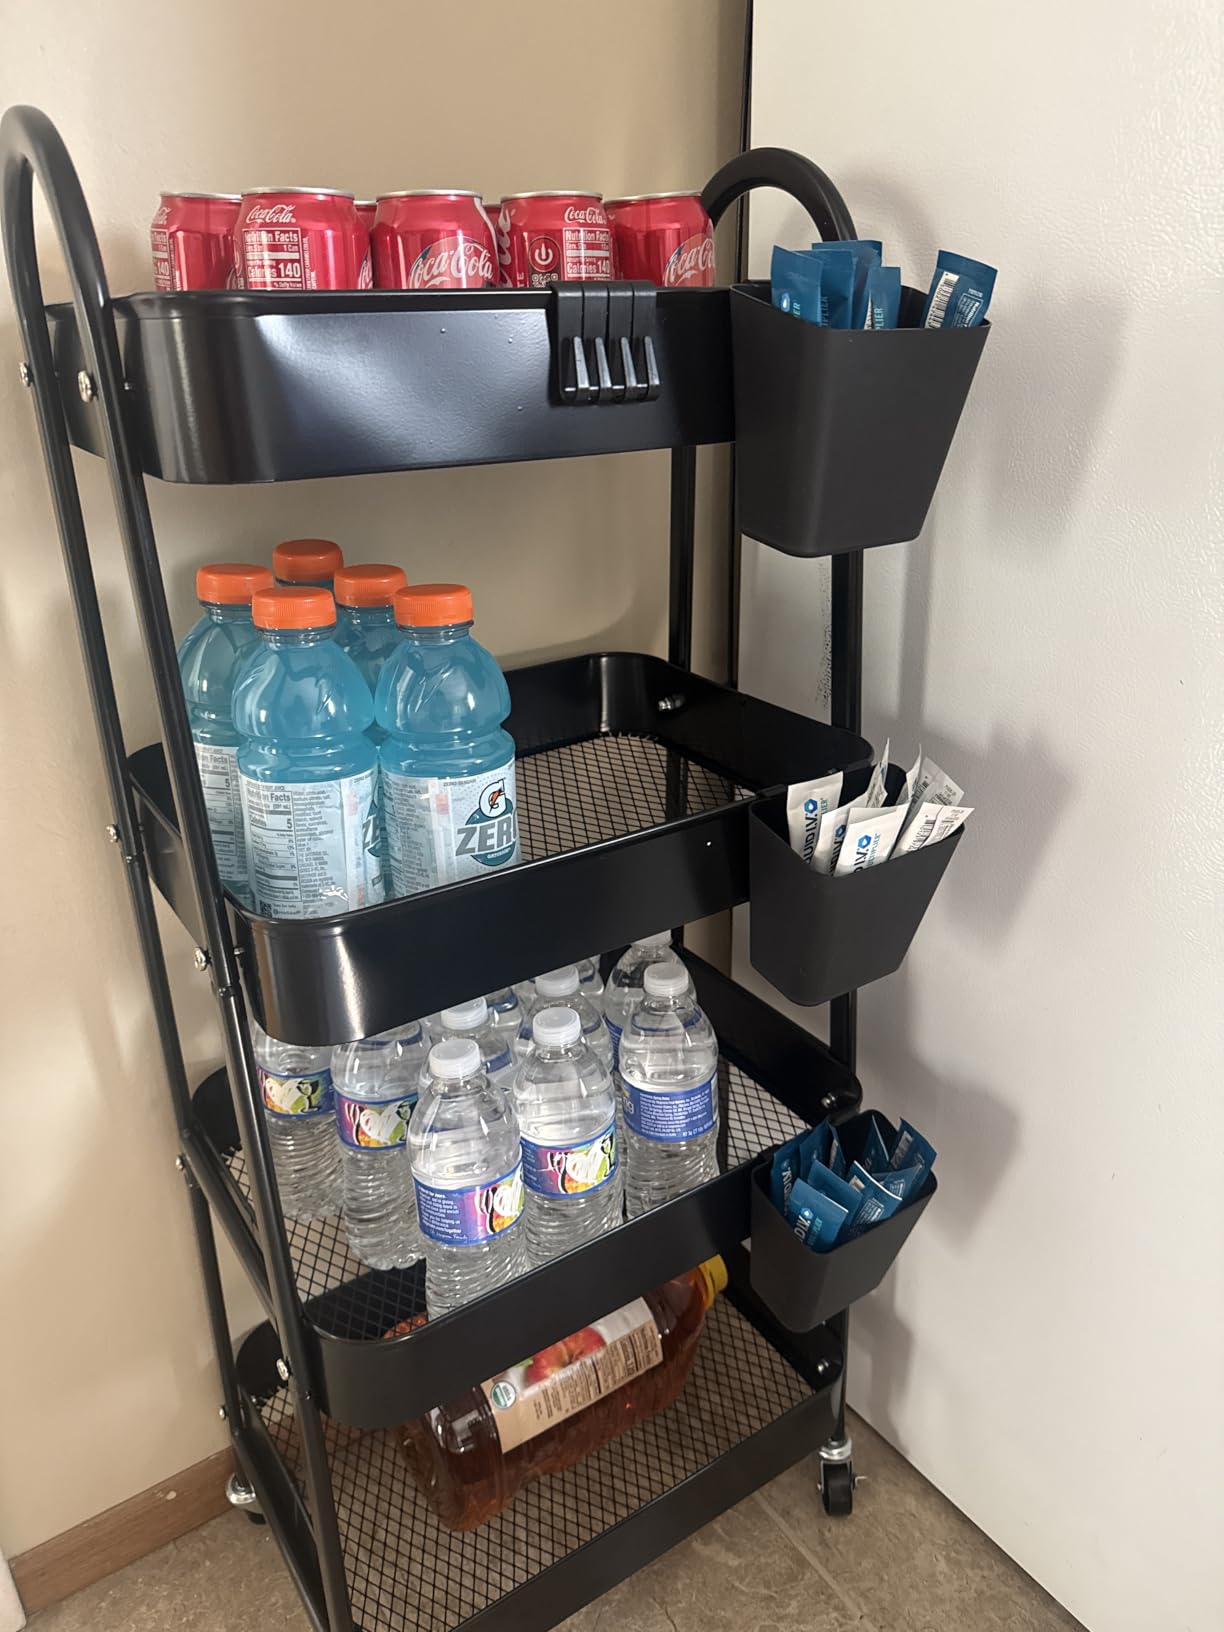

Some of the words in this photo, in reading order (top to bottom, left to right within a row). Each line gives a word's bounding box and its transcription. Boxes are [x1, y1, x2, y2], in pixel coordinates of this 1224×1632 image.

[274, 231, 298, 242] Facts
[278, 262, 301, 278] 140
[270, 793, 291, 802] Facts
[286, 818, 293, 829] 5
